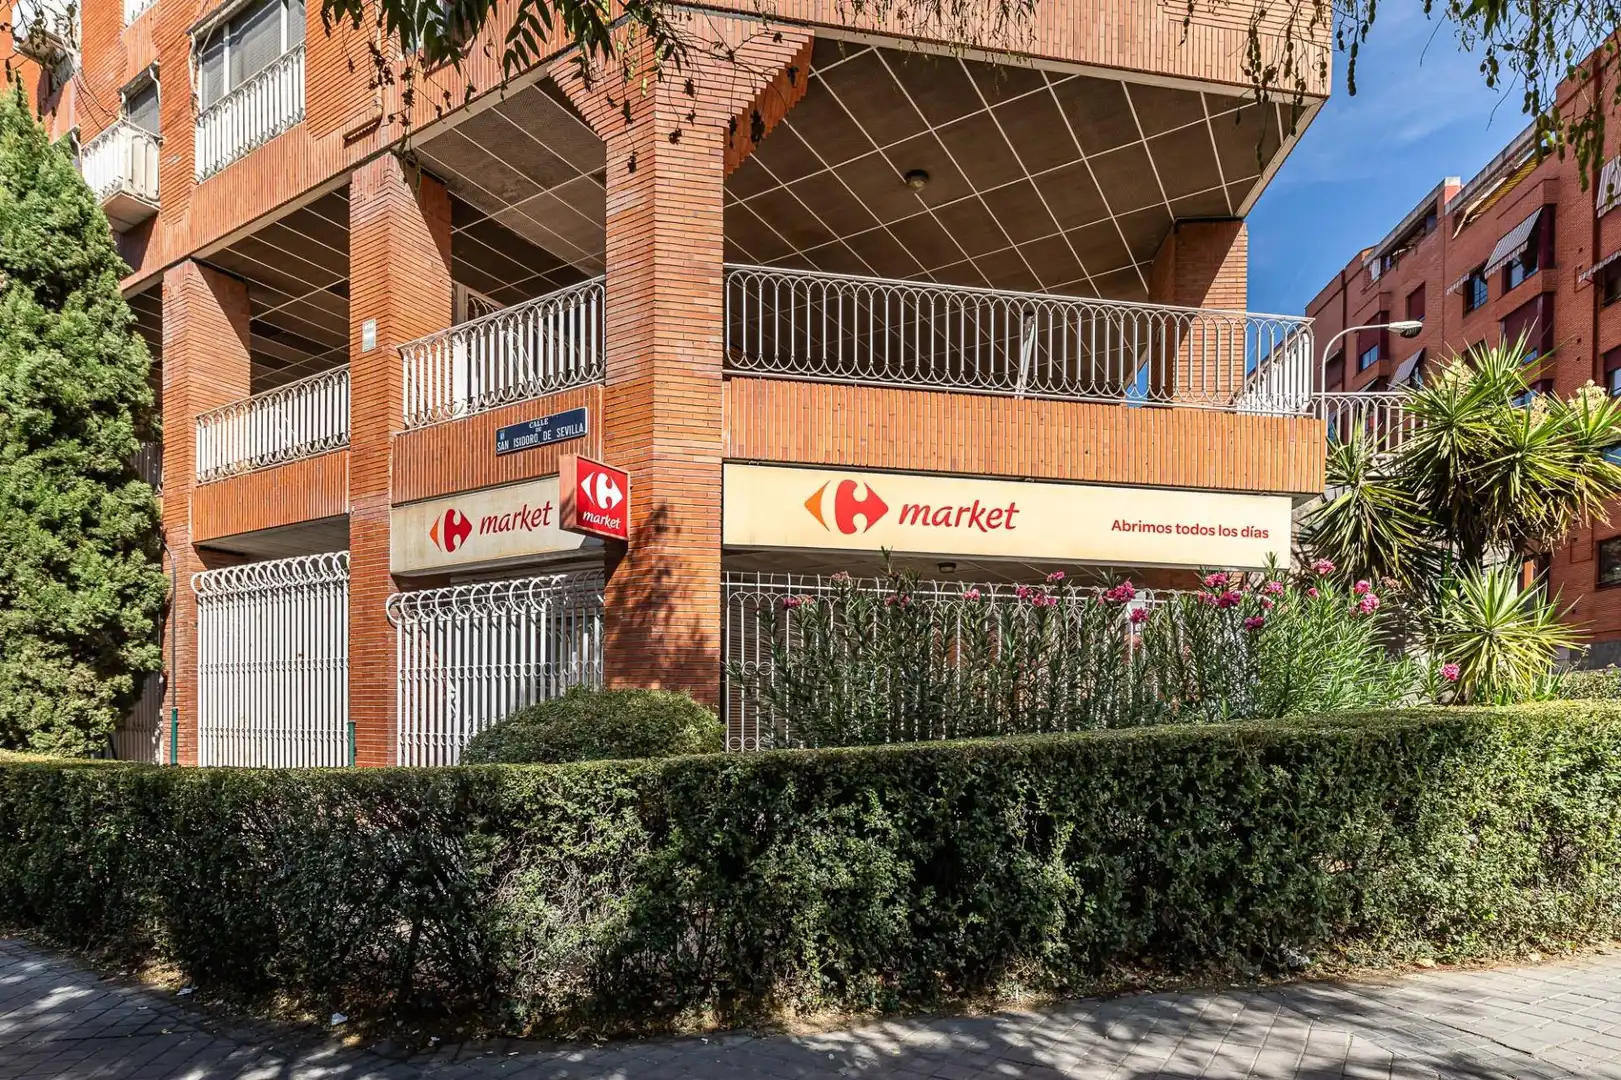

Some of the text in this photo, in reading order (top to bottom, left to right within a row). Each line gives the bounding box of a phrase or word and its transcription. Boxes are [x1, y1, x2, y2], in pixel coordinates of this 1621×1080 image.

[528, 417, 549, 429] CALLE
[497, 422, 584, 452] SAN ISIDORO DE SEVILLA
[479, 500, 553, 535] market
[582, 510, 622, 530] market
[898, 499, 1020, 533] market
[1111, 519, 1269, 539] Abrimos todos los días
